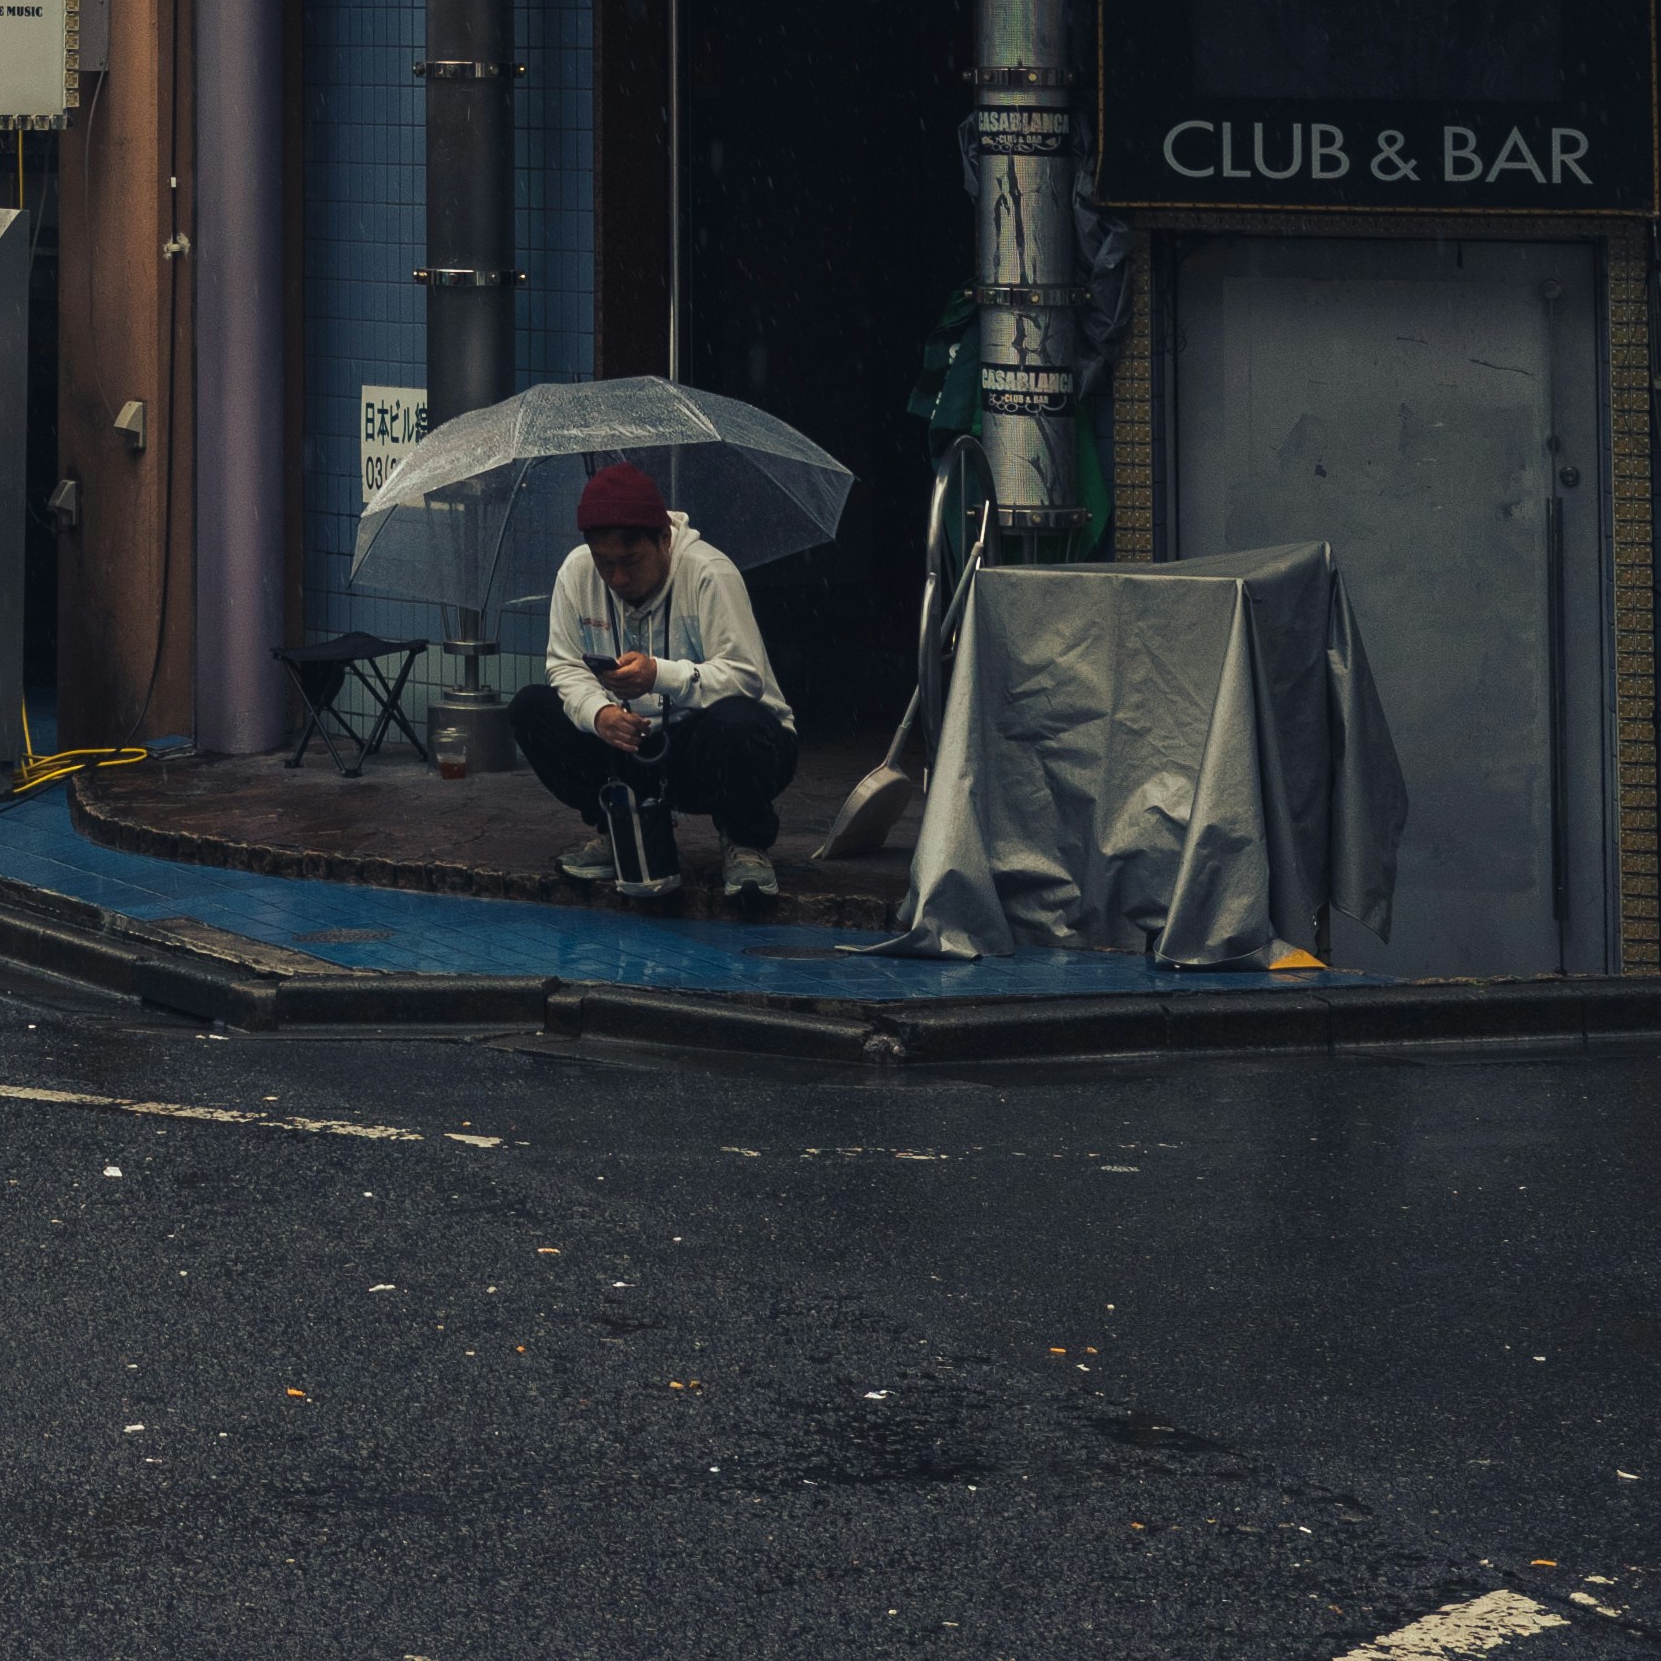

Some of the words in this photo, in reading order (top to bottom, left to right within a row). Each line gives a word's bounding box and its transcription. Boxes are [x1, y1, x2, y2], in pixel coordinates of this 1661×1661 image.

[6, 5, 43, 17] MUSIC
[1162, 119, 1351, 181] CLUB
[1370, 129, 1421, 182] &
[1443, 125, 1594, 186] BAR
